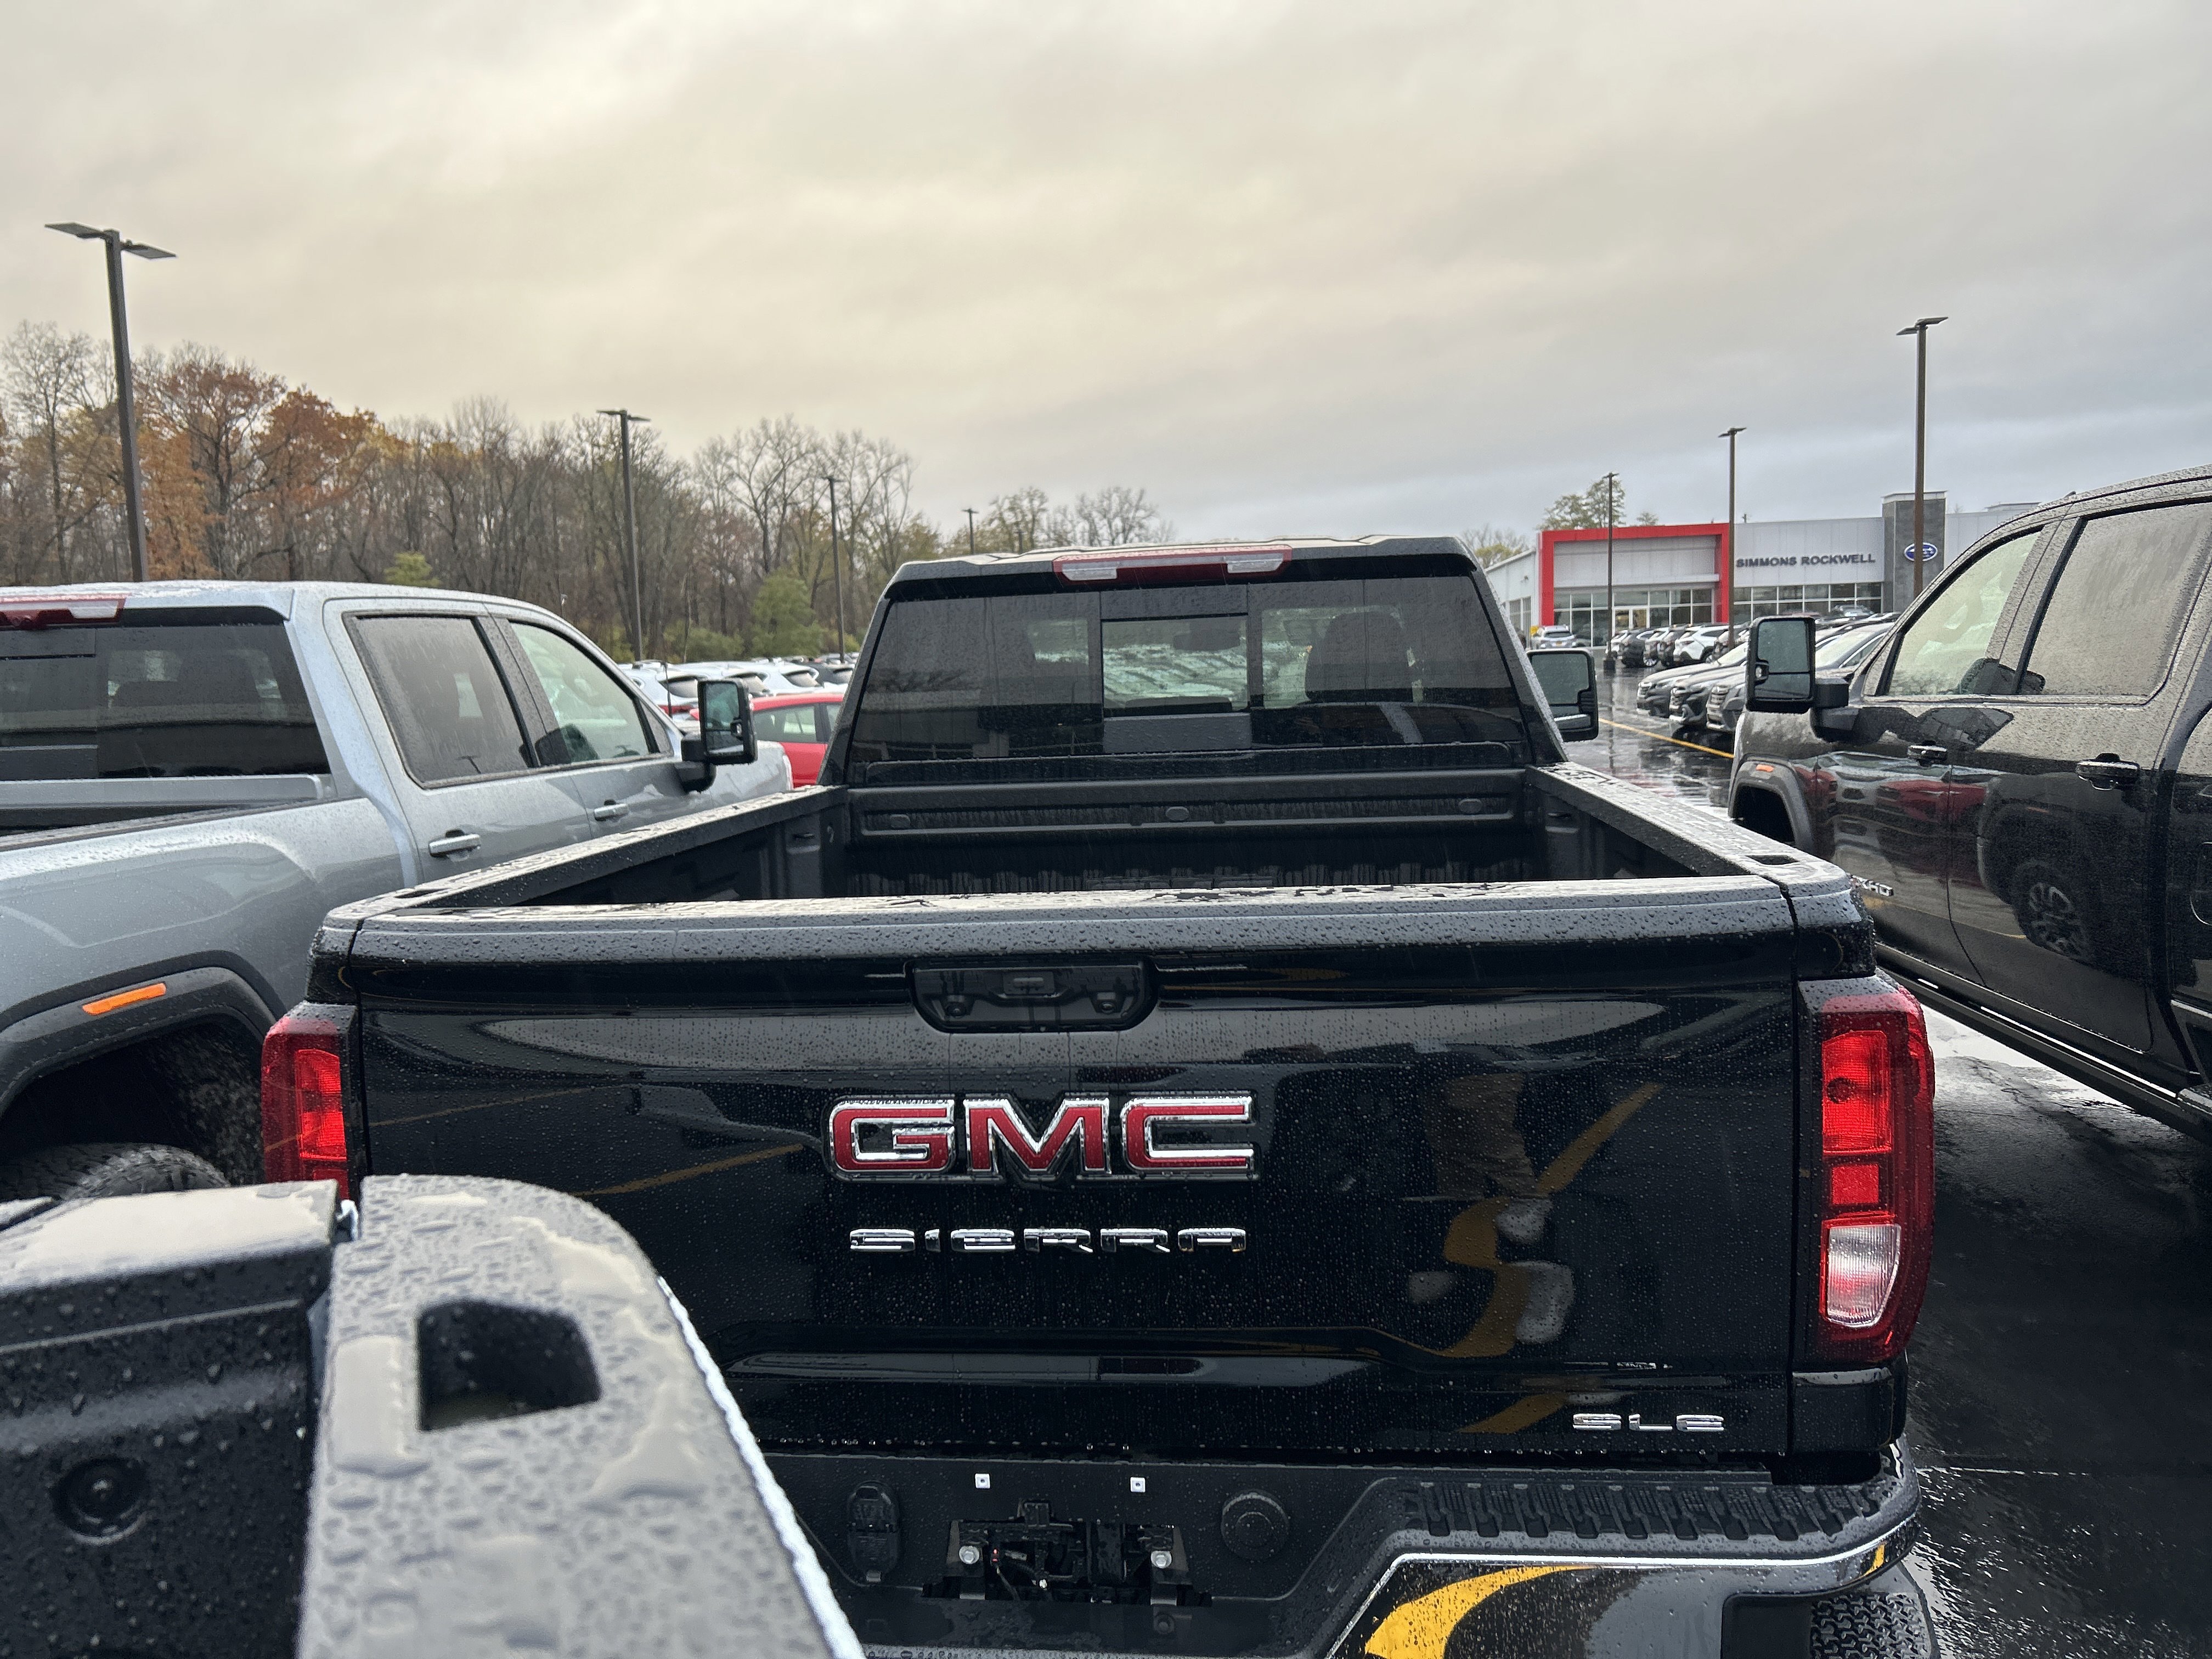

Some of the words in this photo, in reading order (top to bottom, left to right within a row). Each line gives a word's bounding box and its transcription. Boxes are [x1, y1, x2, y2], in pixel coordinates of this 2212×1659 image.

[1736, 556, 1797, 568] SIMMONS
[1801, 554, 1876, 565] ROCKWELL
[829, 1096, 1256, 1175] GMC
[849, 1227, 1247, 1254] SIERRA
[1572, 1413, 1724, 1432] SLE
